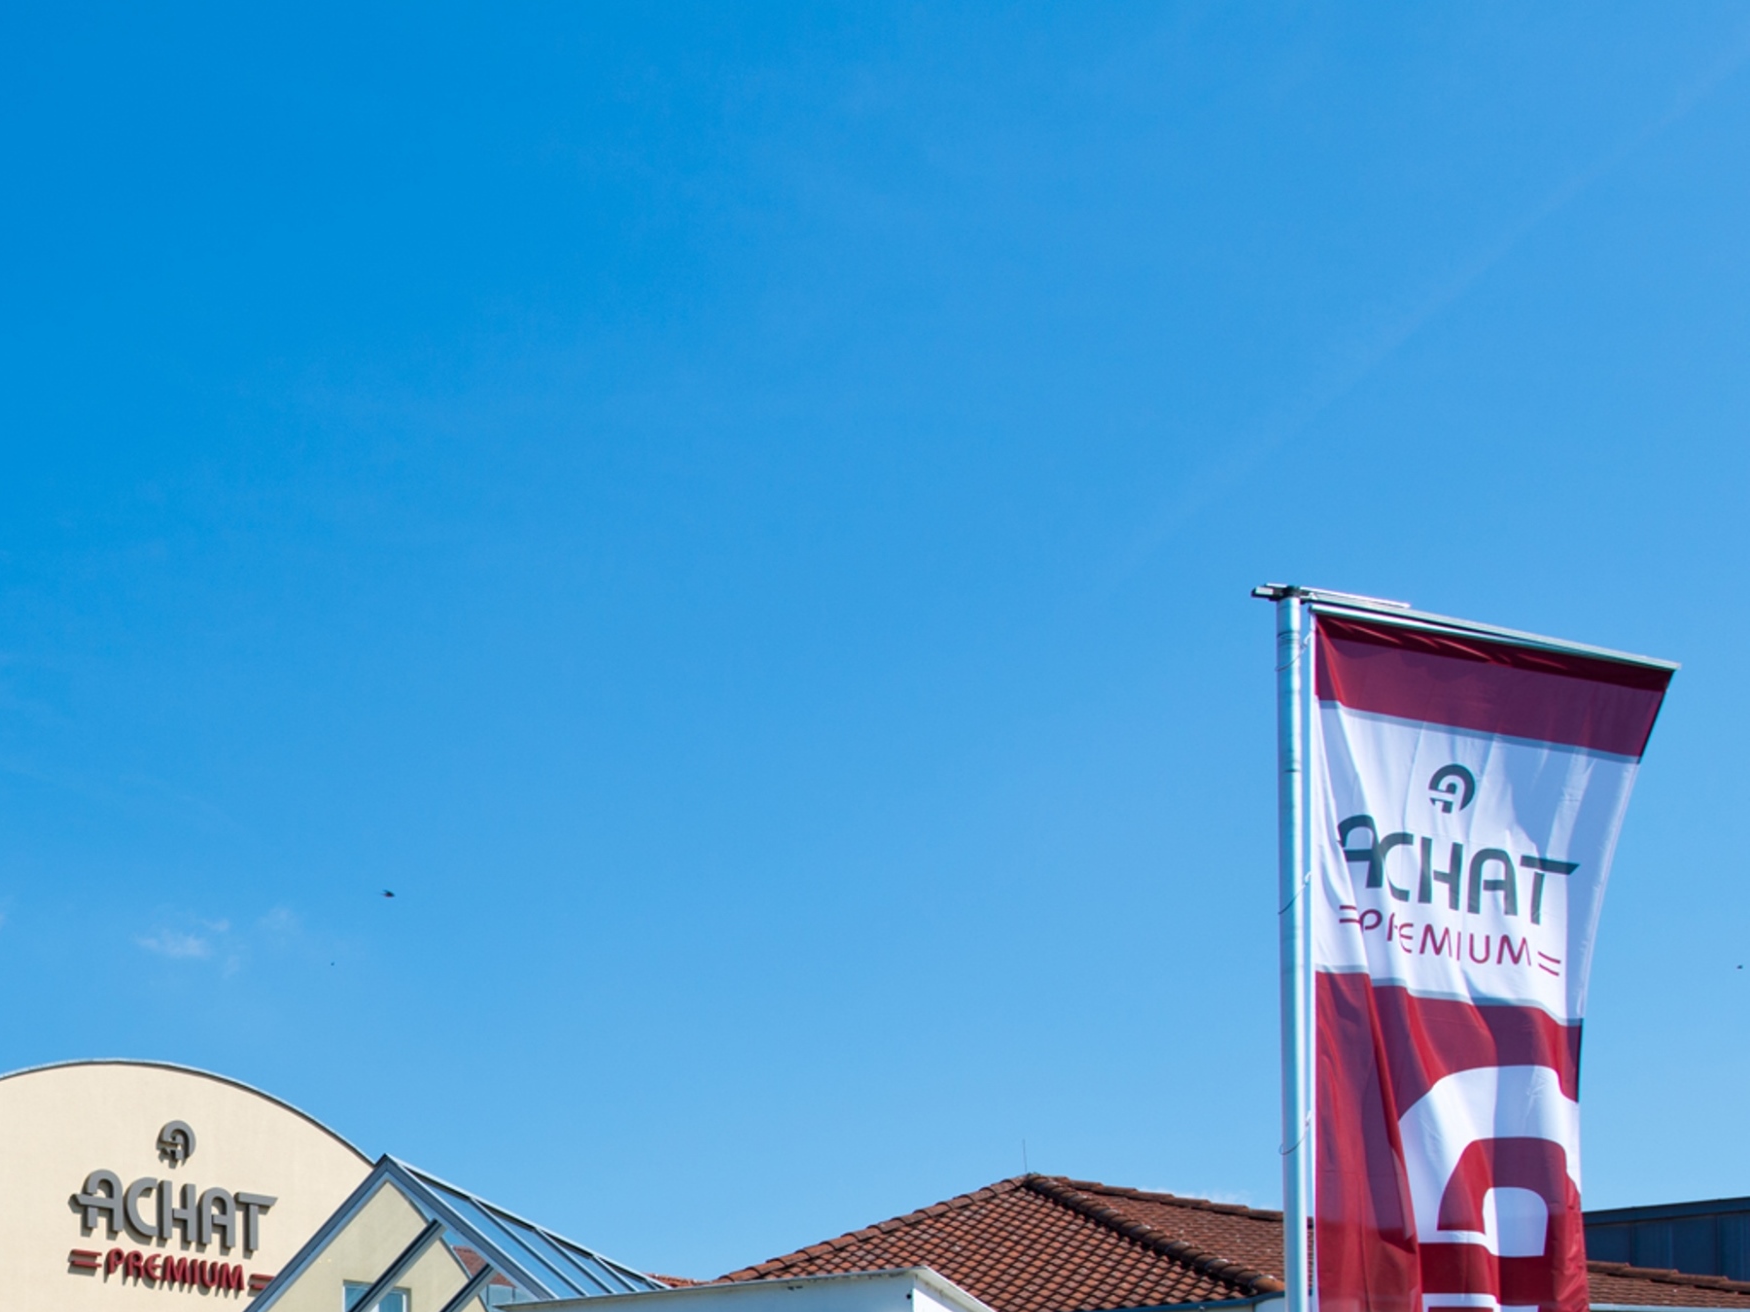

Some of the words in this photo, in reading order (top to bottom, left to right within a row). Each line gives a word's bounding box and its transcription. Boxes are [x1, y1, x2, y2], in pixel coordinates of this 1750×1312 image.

[1337, 814, 1580, 926] ACHAT
[71, 1169, 278, 1251] ACHAT
[107, 1247, 245, 1291] PREMIUM
